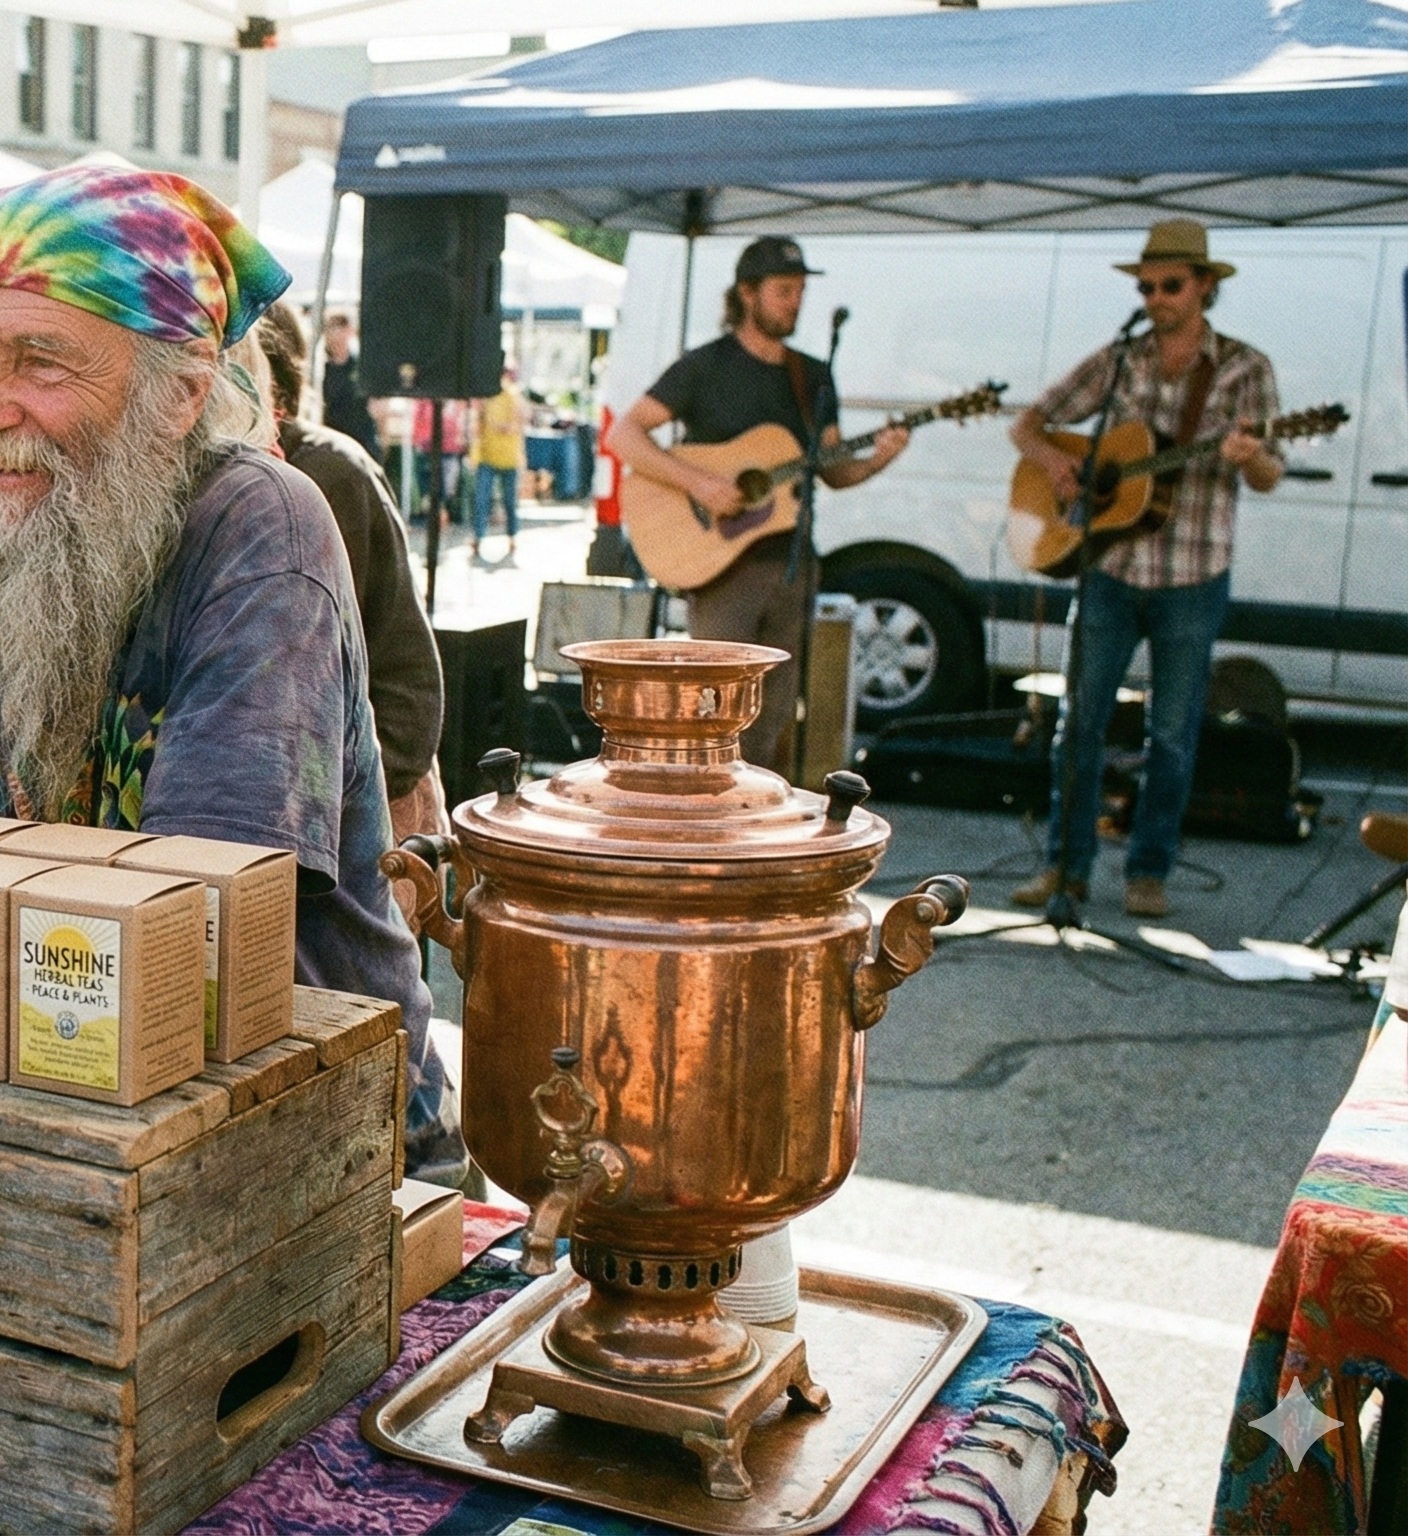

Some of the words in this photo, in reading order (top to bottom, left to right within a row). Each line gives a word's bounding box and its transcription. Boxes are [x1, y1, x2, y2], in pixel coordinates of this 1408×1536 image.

[24, 941, 115, 977] SUNSHINE
[32, 984, 59, 1000] PEACE
[78, 974, 103, 992] TEAS
